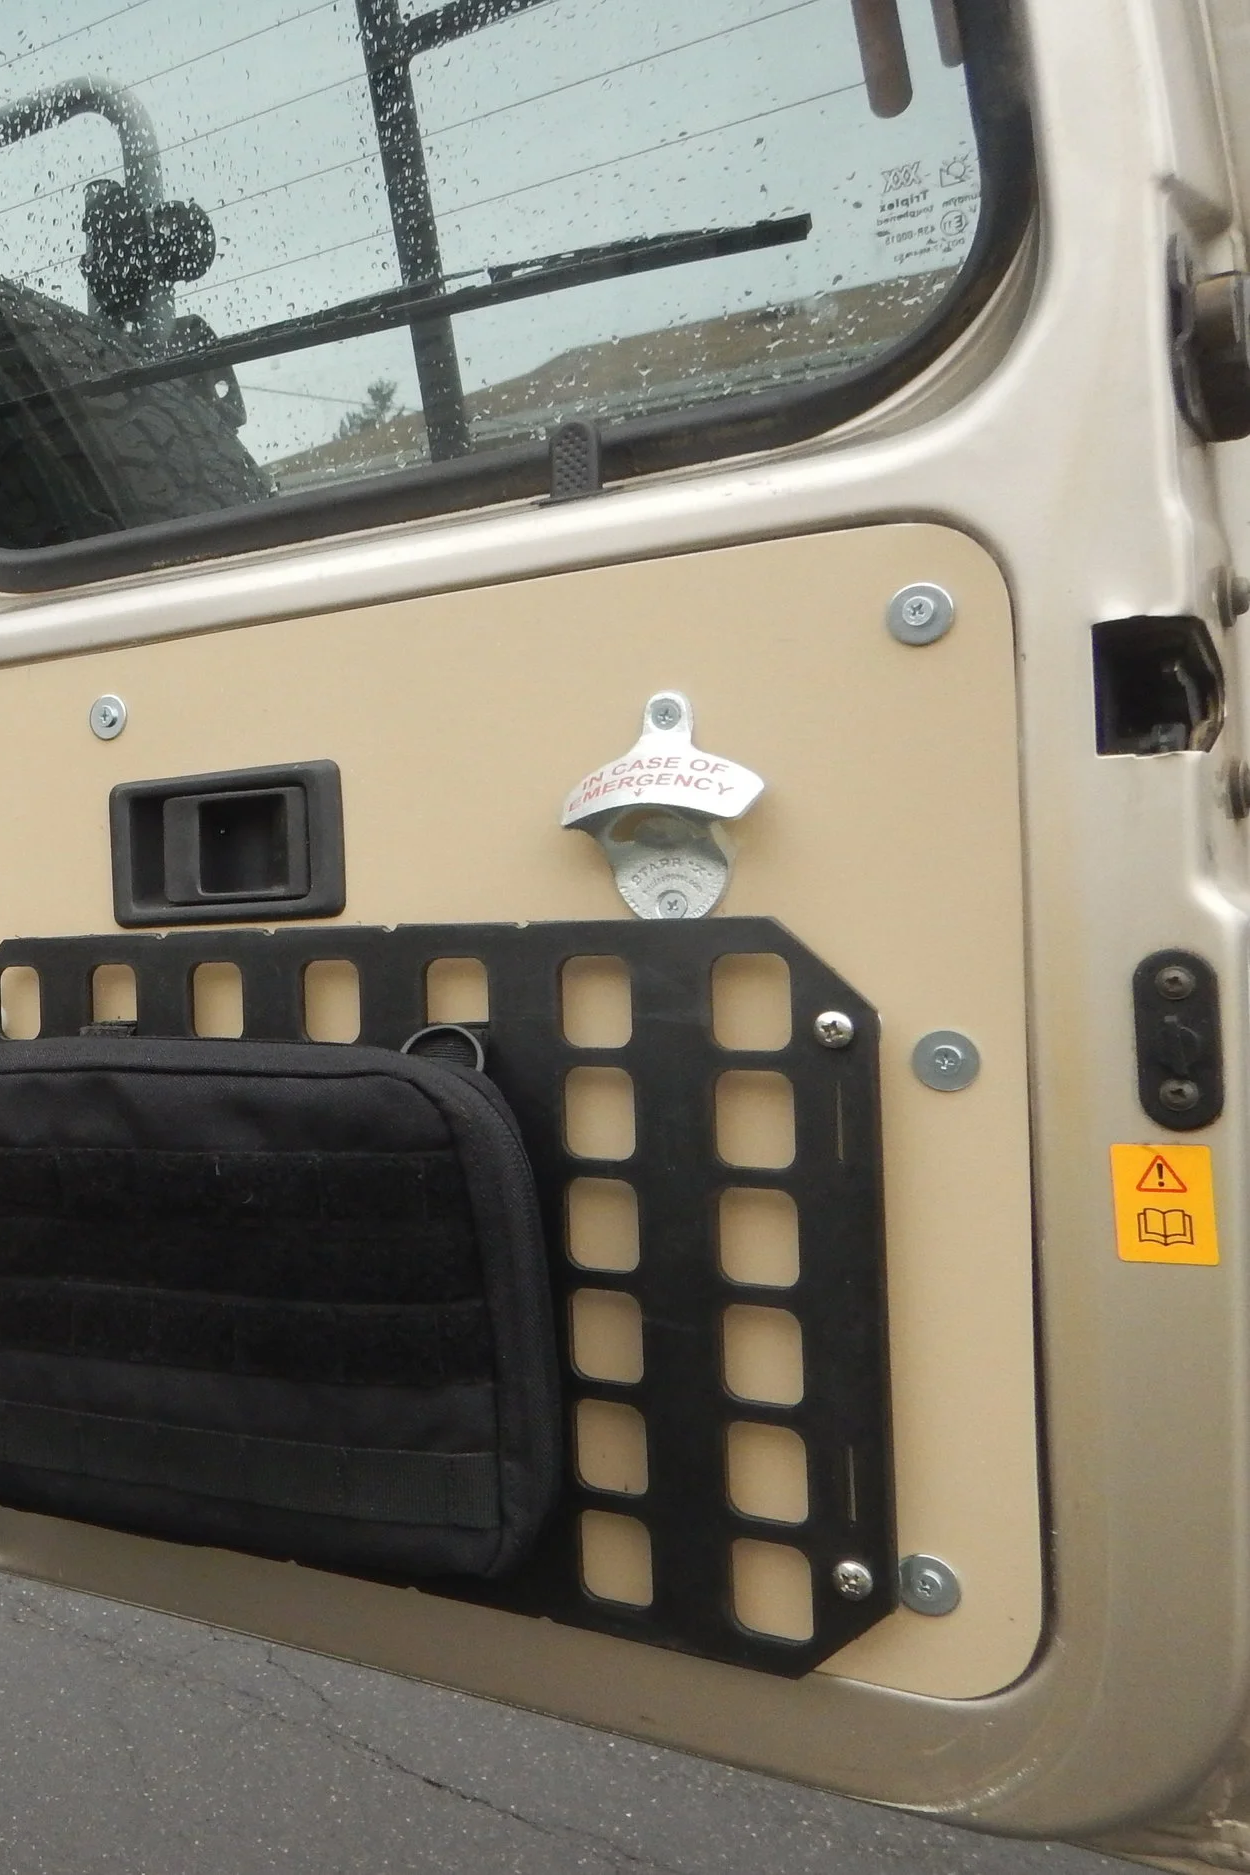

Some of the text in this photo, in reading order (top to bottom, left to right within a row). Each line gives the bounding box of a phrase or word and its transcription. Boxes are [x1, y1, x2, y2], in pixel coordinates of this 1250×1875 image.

[582, 757, 730, 790] IN CASE OF
[569, 773, 735, 812] EMERGENCY
